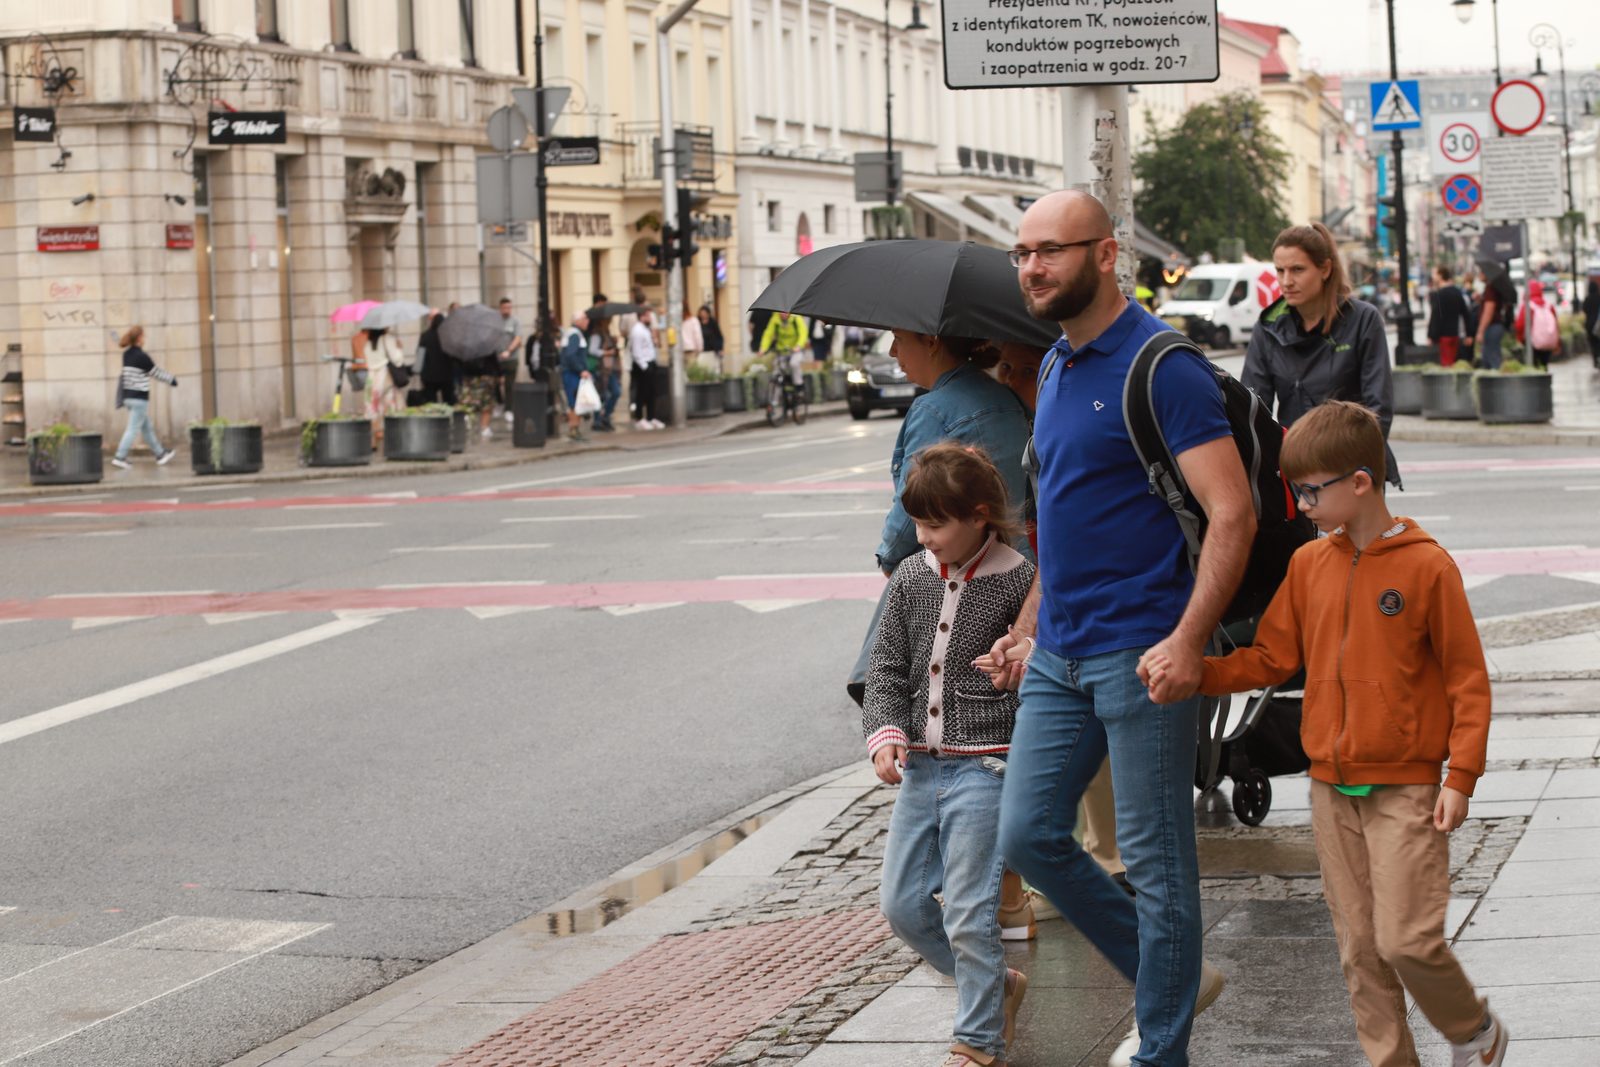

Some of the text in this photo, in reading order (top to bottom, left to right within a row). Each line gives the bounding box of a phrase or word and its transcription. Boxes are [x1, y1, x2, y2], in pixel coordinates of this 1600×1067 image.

[951, 11, 1211, 34] z identyfikatorem TK, nowożeńców,
[986, 33, 1181, 55] konduktów pogrzebowych
[981, 55, 1188, 78] i zaopatrzenia w godz. 20-7
[1447, 133, 1475, 153] 30
